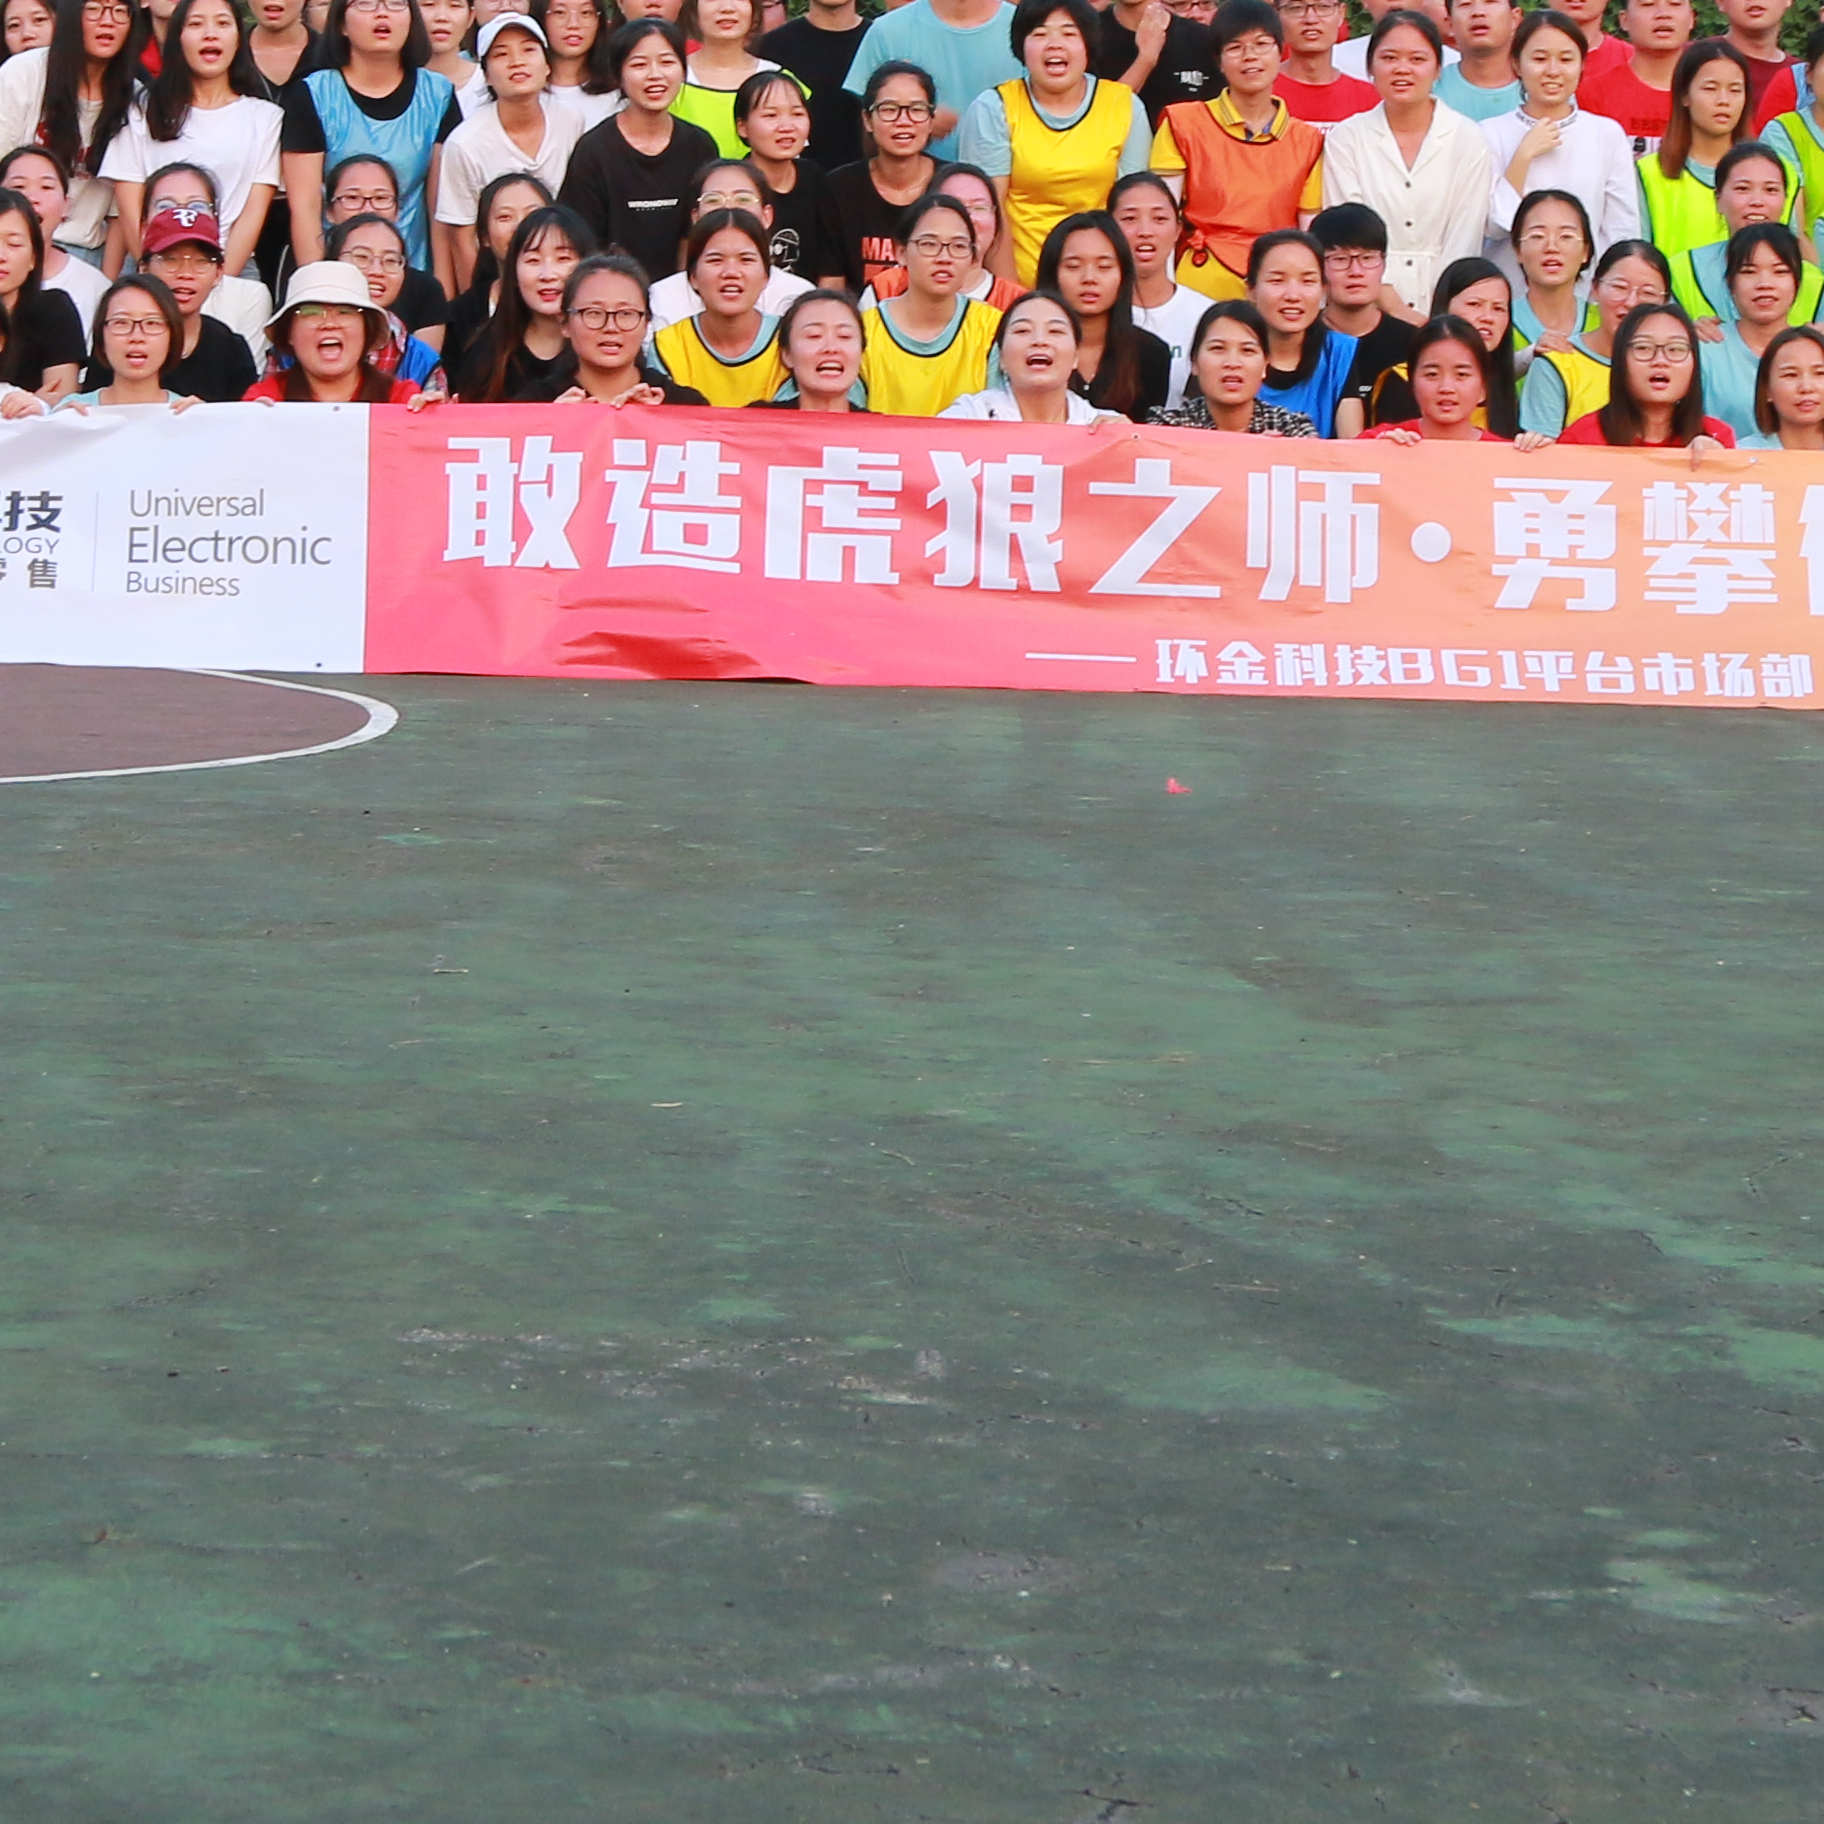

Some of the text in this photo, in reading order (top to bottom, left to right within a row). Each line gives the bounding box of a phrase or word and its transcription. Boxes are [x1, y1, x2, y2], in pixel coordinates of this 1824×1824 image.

[129, 488, 264, 517] Universal
[128, 524, 332, 565] Electronic
[126, 570, 240, 596] Business
